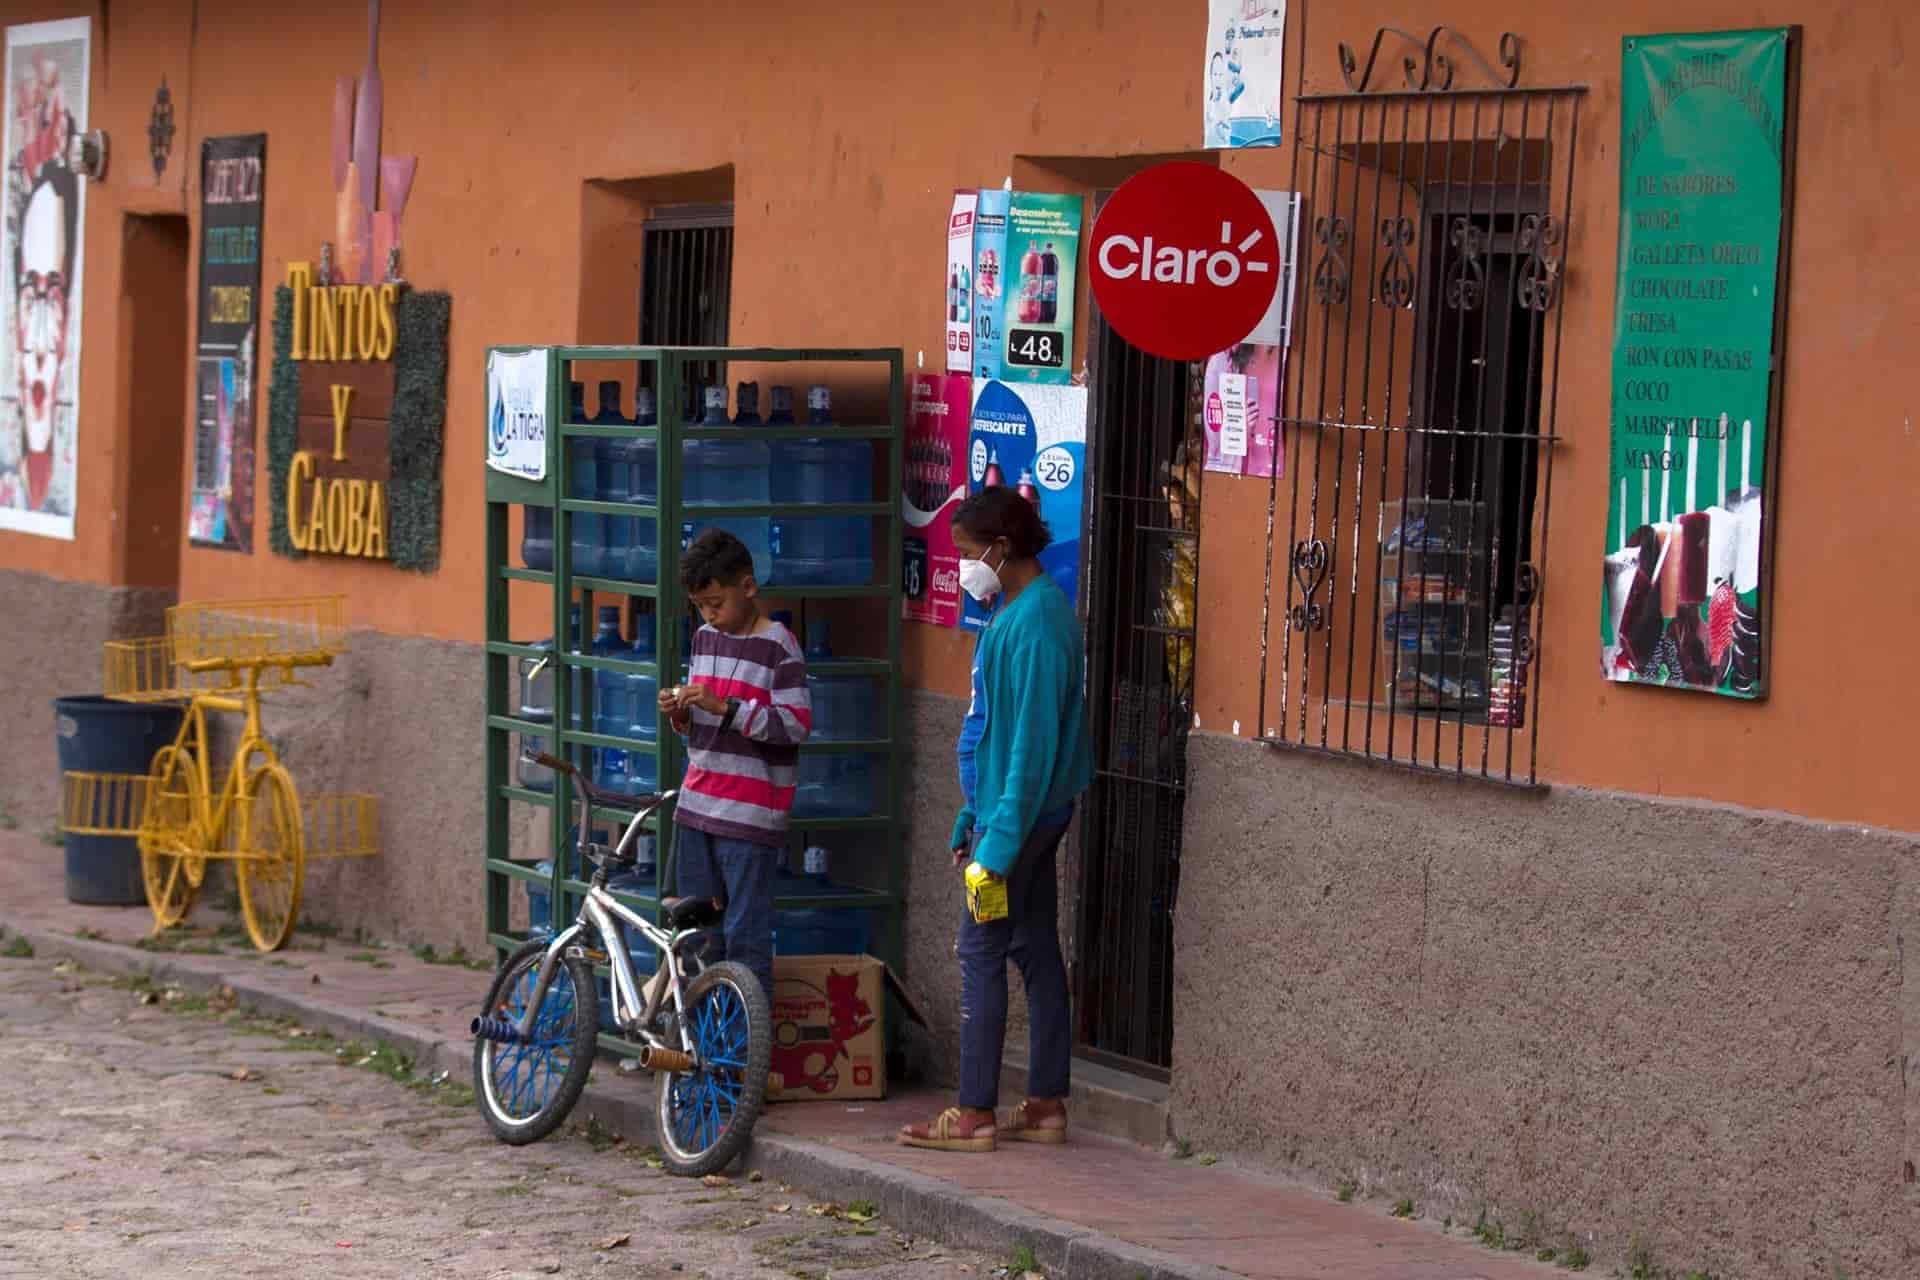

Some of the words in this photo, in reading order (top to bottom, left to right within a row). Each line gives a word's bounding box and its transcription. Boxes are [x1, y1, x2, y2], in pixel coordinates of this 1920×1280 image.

[1635, 209, 1681, 231] MORA
[1098, 235, 1240, 287] Claro
[1632, 244, 1707, 265] GALLETA
[1711, 245, 1761, 265] OREO
[1631, 278, 1729, 300] CHOCOLATE
[287, 261, 397, 361] TINTOS
[1628, 312, 1677, 333] FRESA
[1019, 335, 1052, 362] 48
[1626, 346, 1659, 369] RON
[1664, 348, 1697, 369] CON
[1702, 349, 1753, 371] PASAS
[1625, 379, 1670, 402] COCO
[329, 384, 352, 462] Y
[506, 413, 518, 441] LA
[1625, 448, 1684, 471] MANGO
[287, 451, 388, 559] CAOBA
